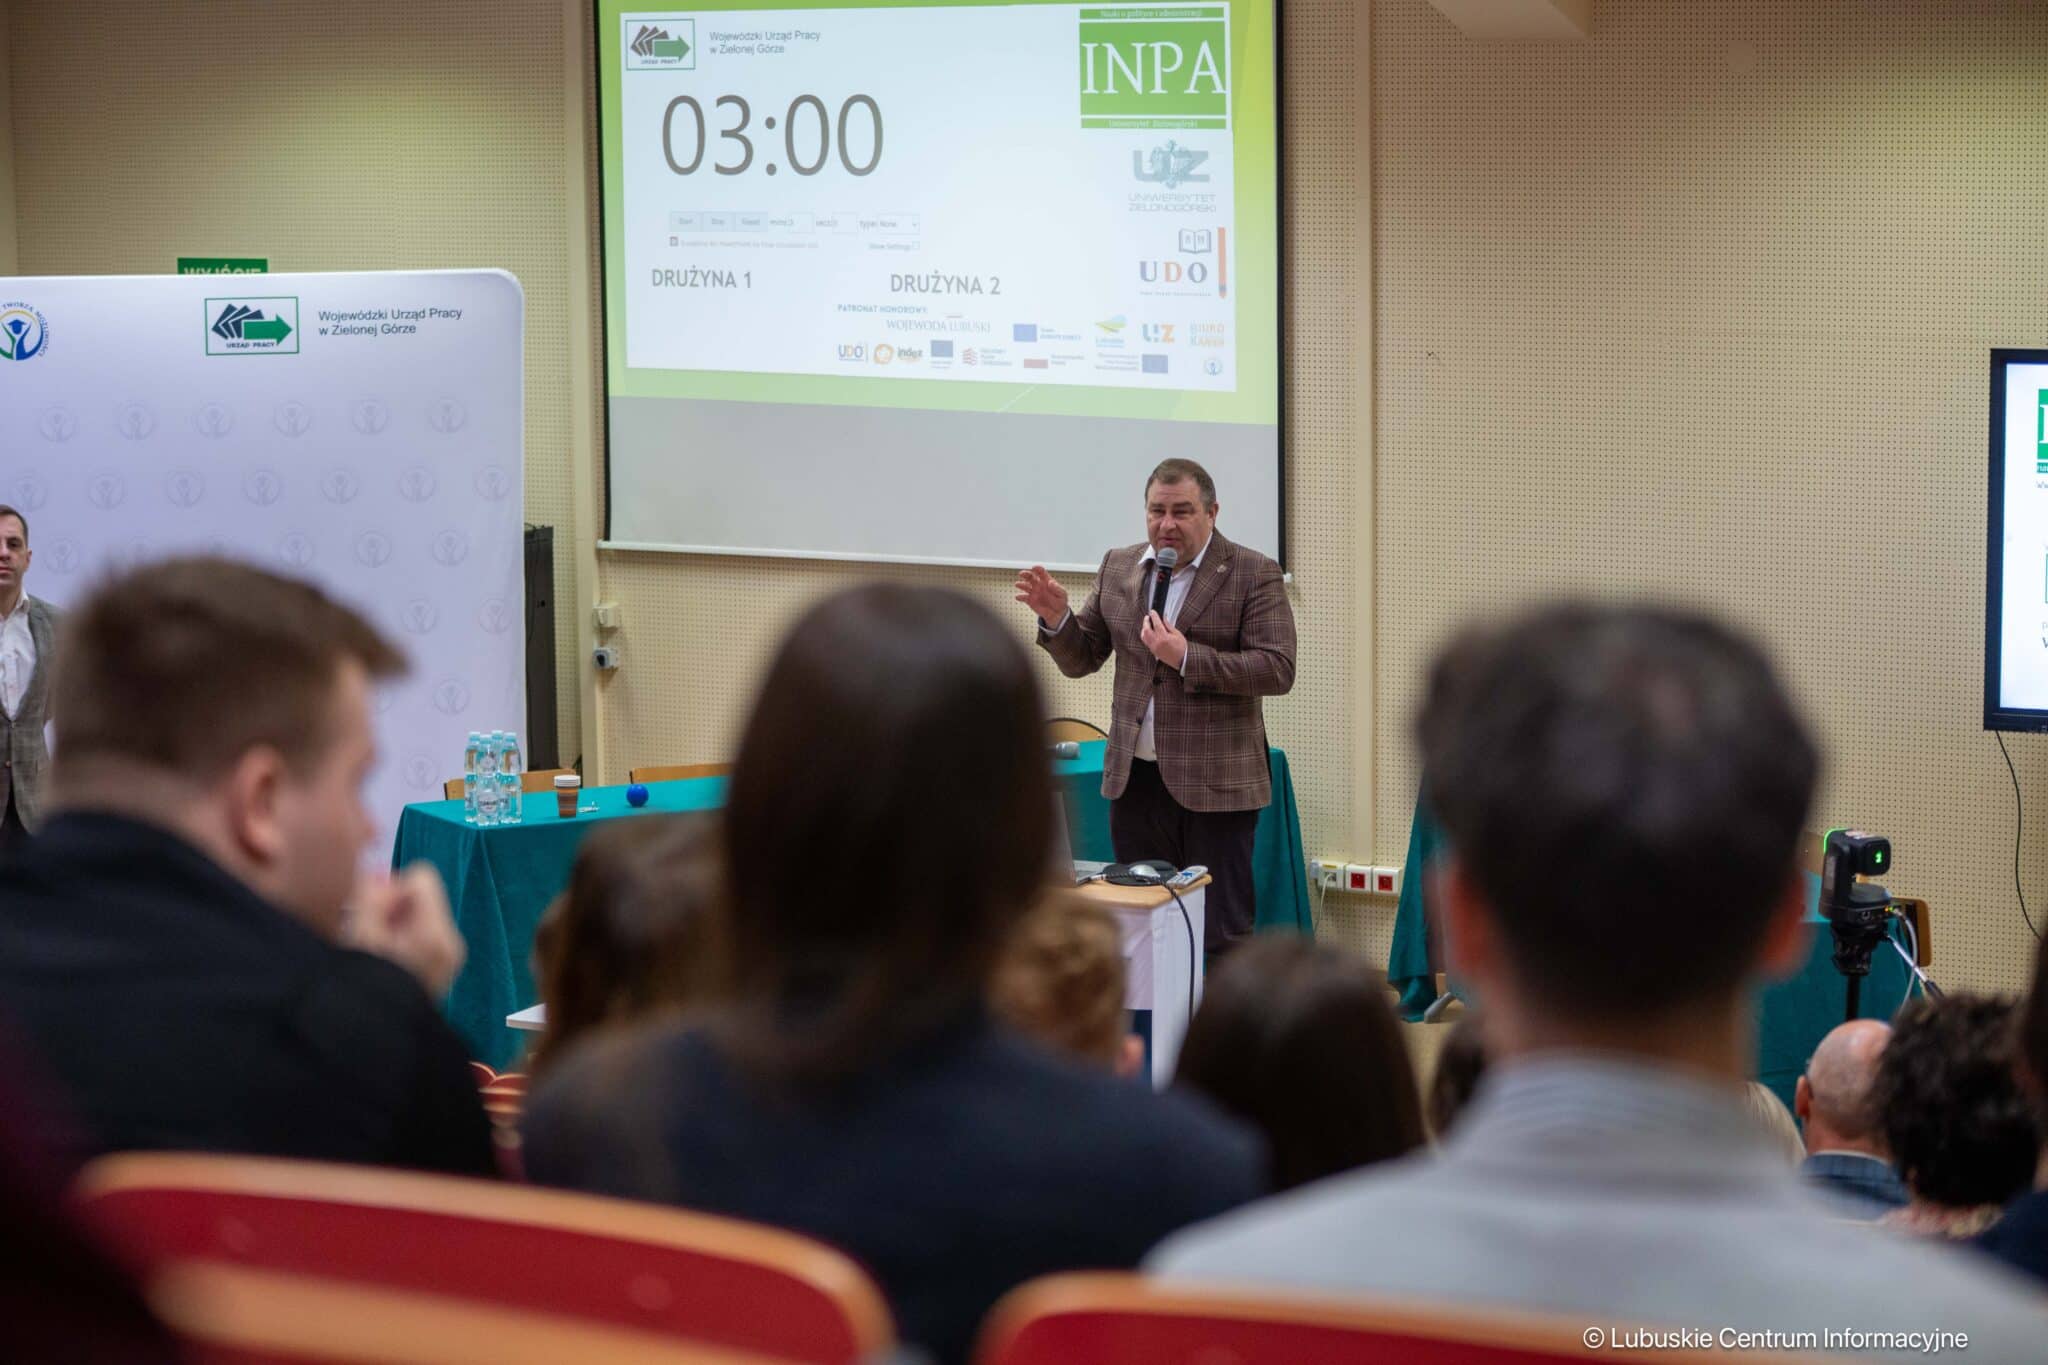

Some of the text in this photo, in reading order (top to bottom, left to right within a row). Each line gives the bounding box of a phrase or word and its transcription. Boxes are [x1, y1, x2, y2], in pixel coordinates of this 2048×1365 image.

[795, 30, 821, 42] Pracy
[709, 43, 785, 56] w Zielonej Górze
[1081, 40, 1227, 95] INPA
[662, 94, 883, 176] 03:00
[652, 264, 752, 289] DRUŻYNA 1
[1140, 261, 1208, 283] UDO
[890, 270, 1001, 296] DRUŻYNA 2
[318, 308, 463, 324] Wojewódzki Urząd Pracy
[837, 303, 878, 313] PATRONAT
[318, 323, 417, 337] w Zielonej Górze
[886, 319, 947, 332] WOJEWODA
